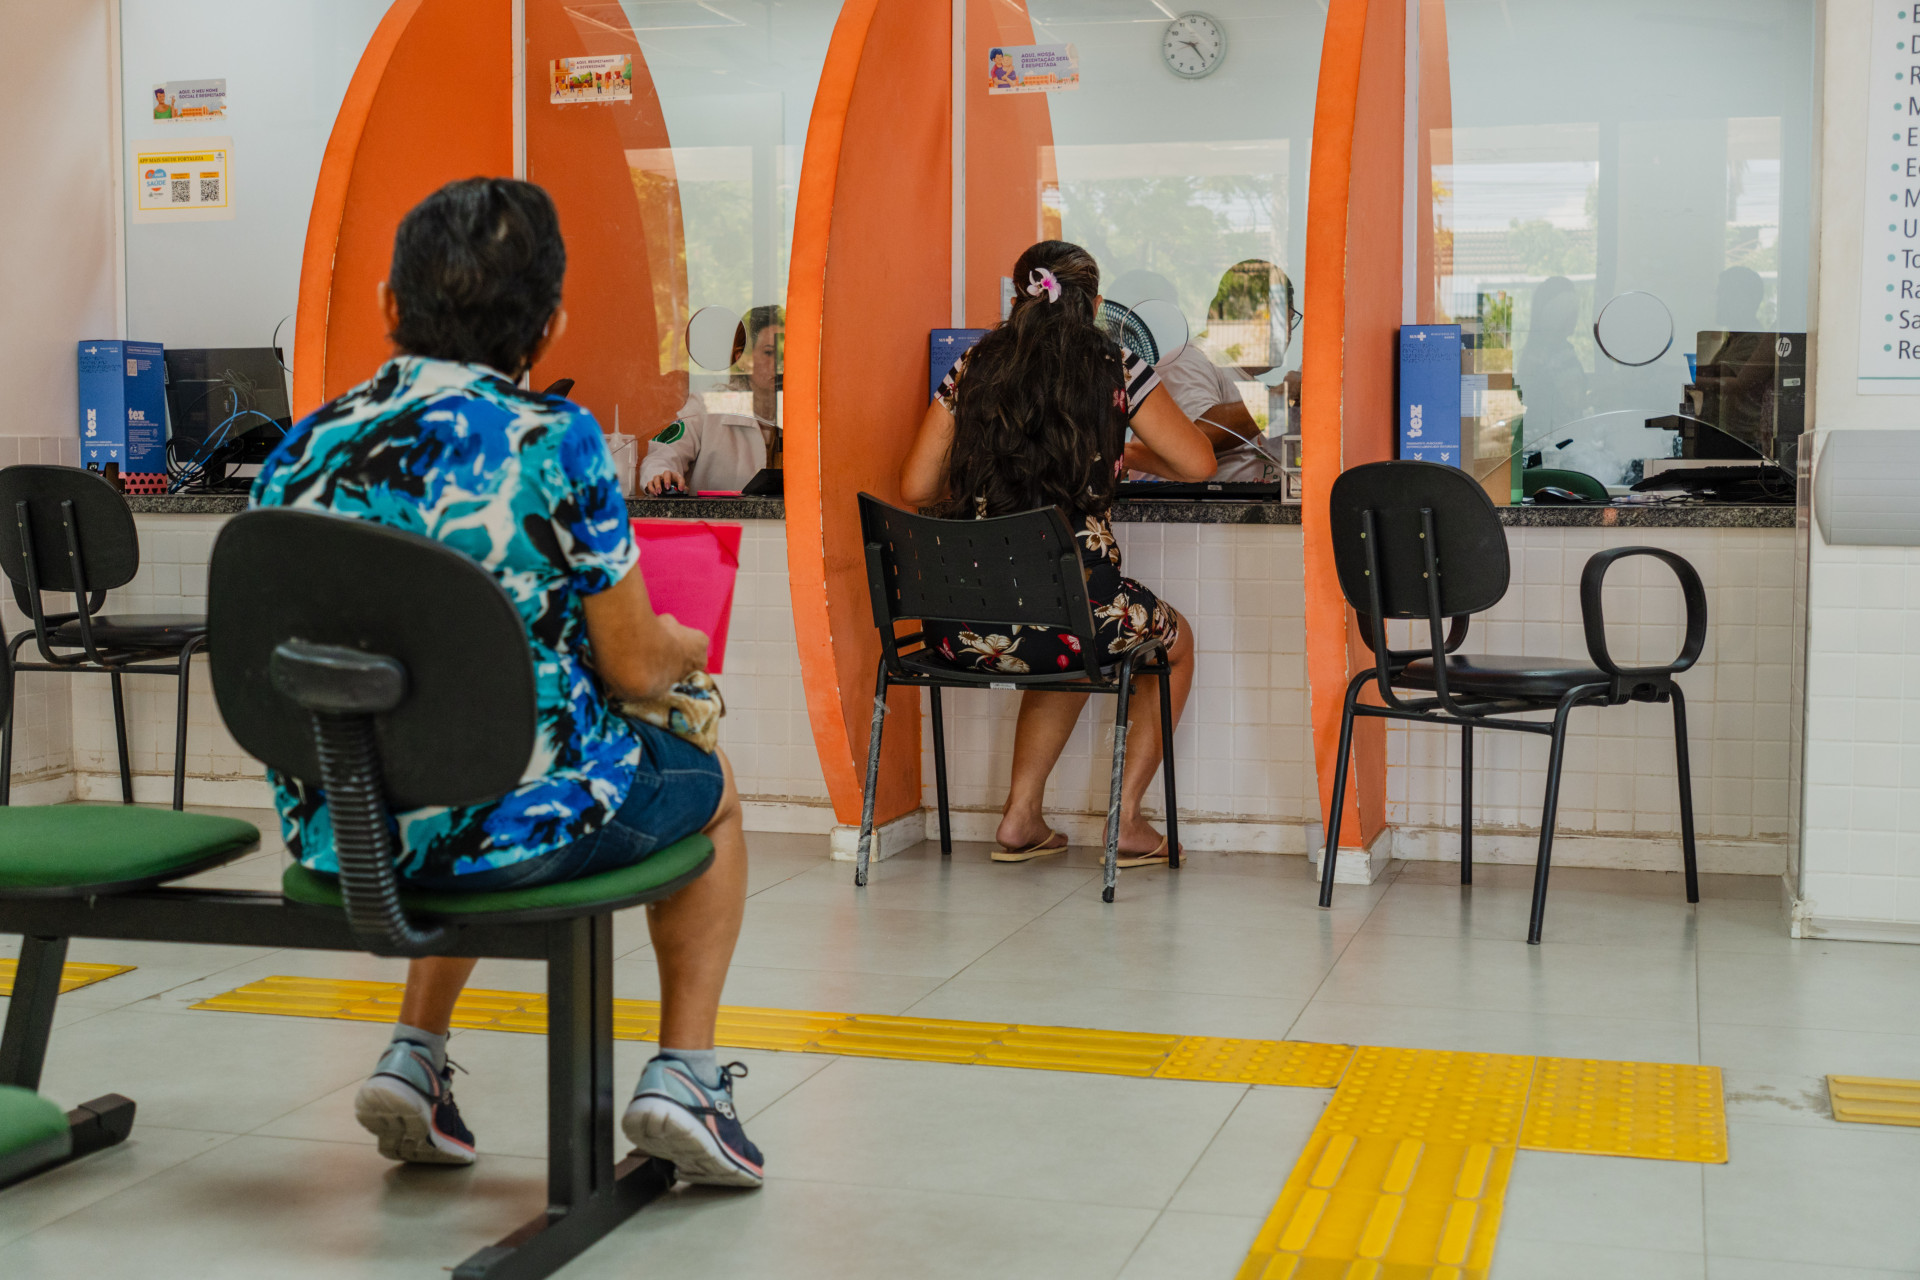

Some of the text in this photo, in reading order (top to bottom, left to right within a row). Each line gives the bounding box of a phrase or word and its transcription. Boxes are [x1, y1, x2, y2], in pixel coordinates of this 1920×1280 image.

[1021, 56, 1054, 64] ORIENTAÇÃO
[146, 178, 166, 187] SAÚDE
[1901, 249, 1920, 269] To
[1899, 309, 1920, 329] Sa
[1778, 337, 1790, 357] hp
[1898, 340, 1920, 360] Re
[85, 408, 97, 438] tex
[128, 407, 145, 421] tex
[1406, 404, 1423, 438] tex
